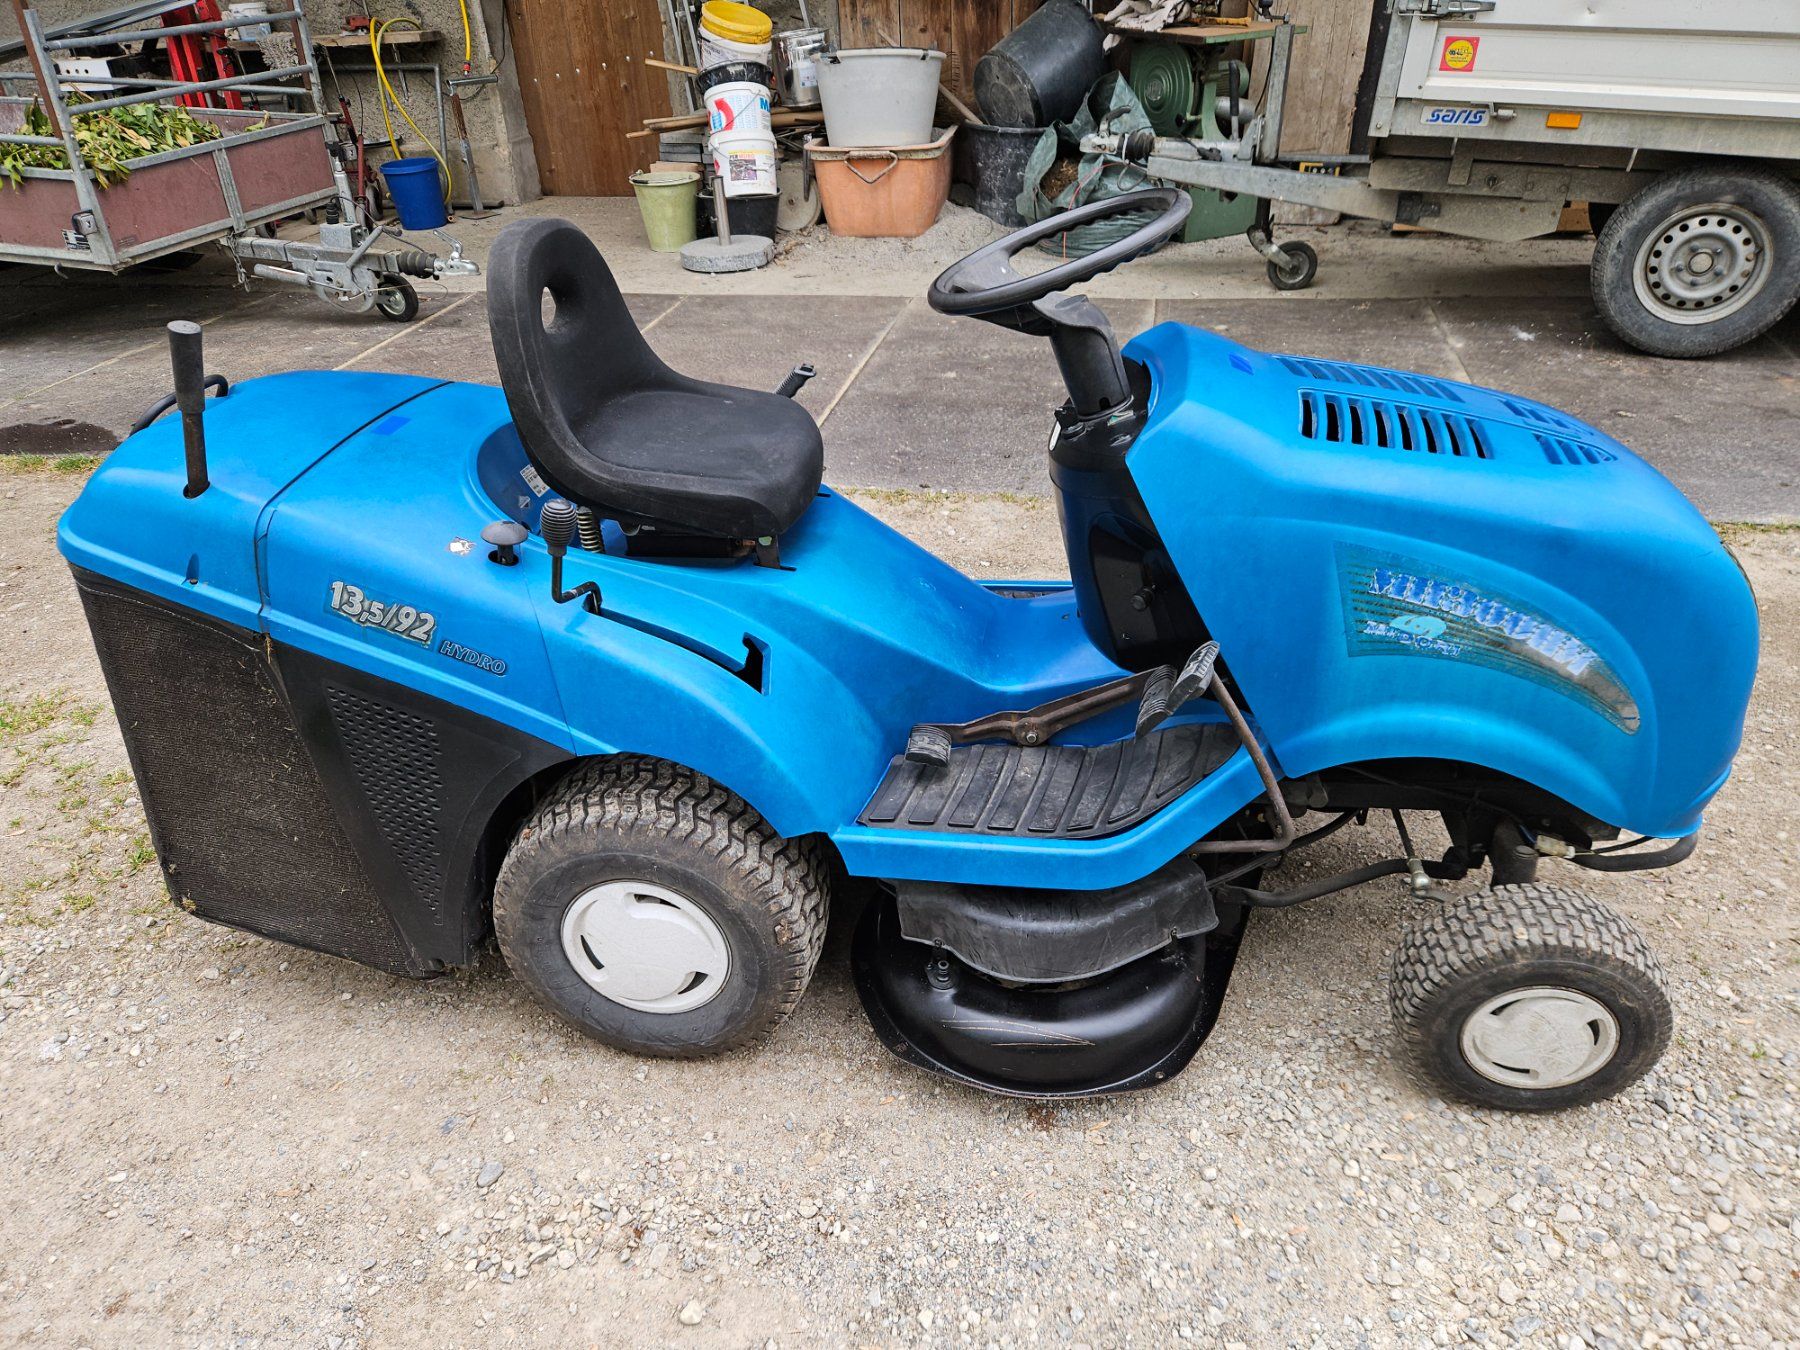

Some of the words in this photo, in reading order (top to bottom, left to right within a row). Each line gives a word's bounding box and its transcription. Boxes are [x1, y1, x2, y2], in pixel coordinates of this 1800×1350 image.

[1426, 108, 1486, 124] saris
[331, 581, 436, 641] 13,5/92
[440, 640, 506, 675] HYDRO
